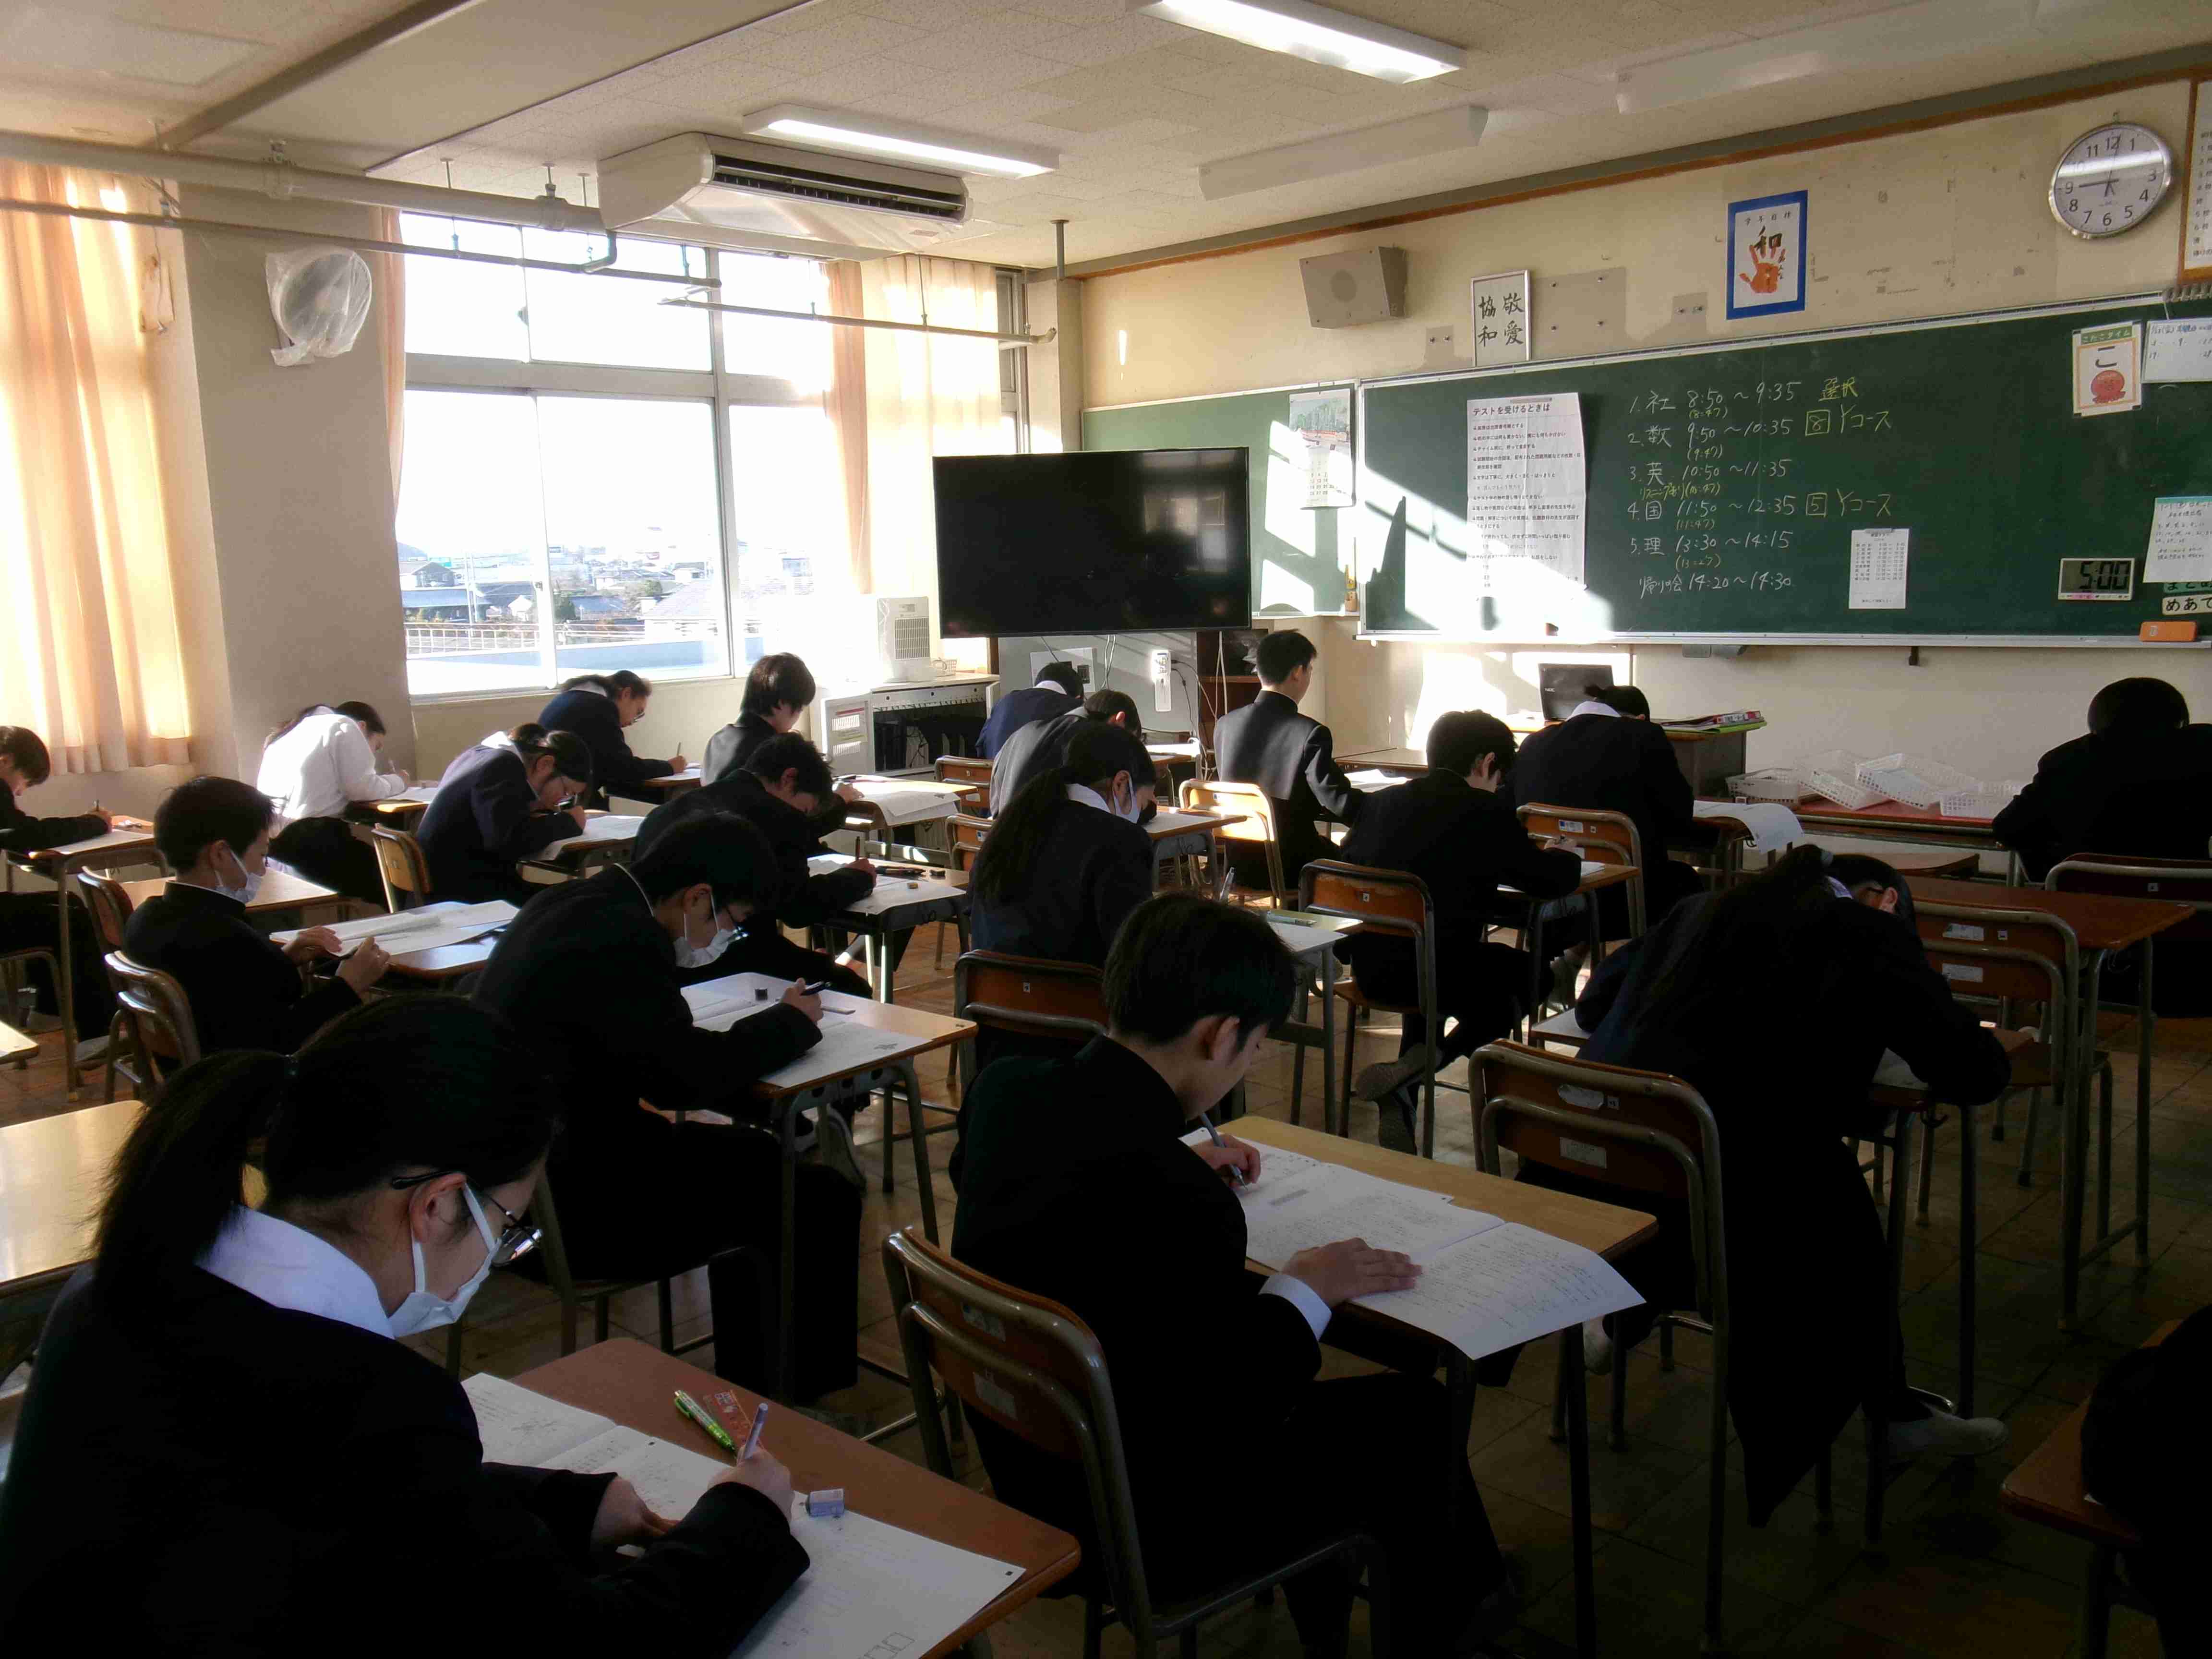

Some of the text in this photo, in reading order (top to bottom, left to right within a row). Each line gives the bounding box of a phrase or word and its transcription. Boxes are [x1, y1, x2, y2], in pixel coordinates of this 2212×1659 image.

[2105, 136, 2120, 150] 12
[2129, 138, 2135, 151] 1
[2086, 144, 2098, 157] 11
[2148, 169, 2157, 182] 3
[2065, 181, 2073, 194] 9
[2139, 189, 2149, 202] 4
[2069, 199, 2078, 212] 8
[2124, 205, 2133, 219] 5
[2083, 211, 2092, 224] 7
[2103, 213, 2112, 226] 6
[1478, 295, 1498, 347] 協和
[1503, 292, 1525, 346] 敬愛
[1472, 403, 1551, 416] テストを受けるときは
[2079, 561, 2129, 589] 5:00
